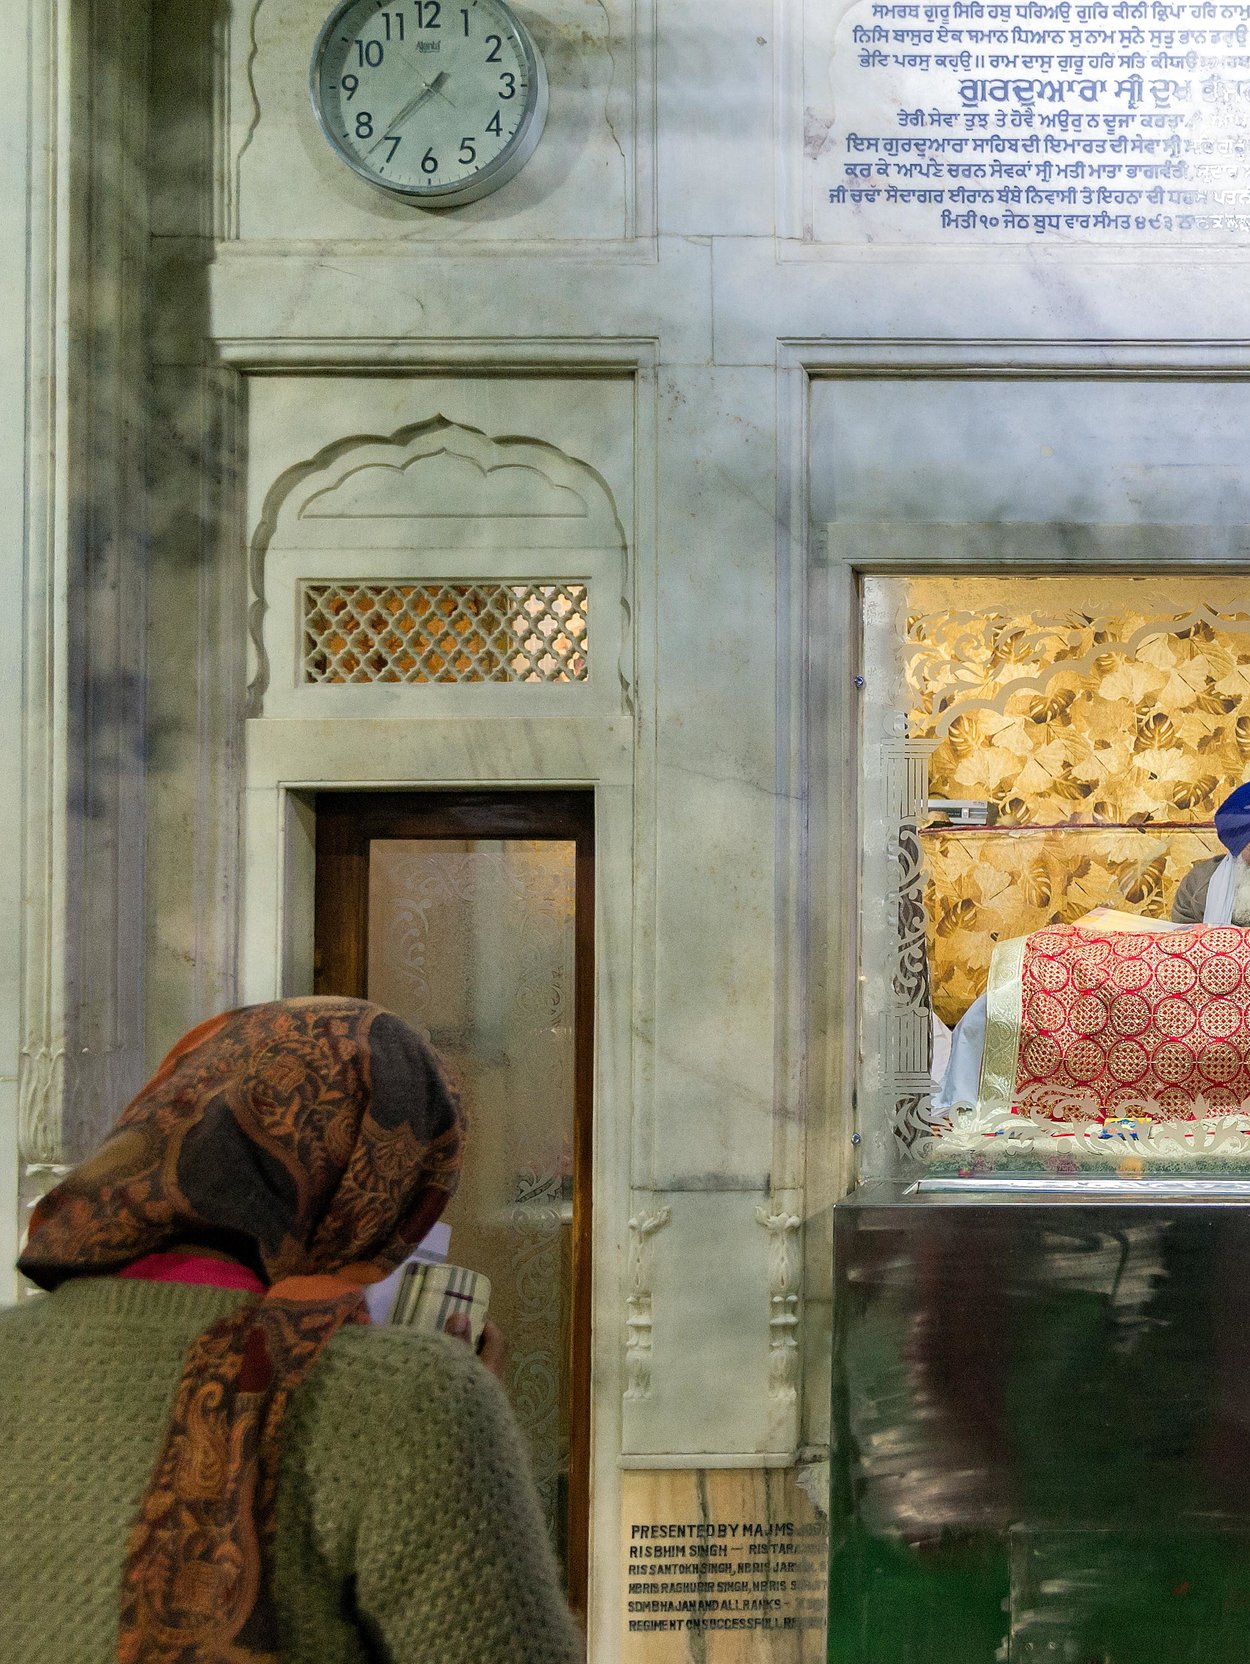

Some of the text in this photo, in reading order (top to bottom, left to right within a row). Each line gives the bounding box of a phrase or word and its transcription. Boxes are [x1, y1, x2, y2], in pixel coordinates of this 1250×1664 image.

[414, 1, 441, 29] 12
[460, 9, 470, 36] 1
[872, 3, 919, 19] ਸਮਰਥ
[924, 5, 950, 24] ਗੁਰੂ
[954, 1, 984, 19] ਸਿਰਿ
[987, 5, 1012, 22] ਹਥੁ
[1076, 1, 1108, 23] ਗੁਰਿ
[1113, 1, 1148, 19] ਕੀਨੀ
[1190, 1, 1217, 18] ਹਰਿ
[1220, 5, 1250, 21] ਨਾਮੁ
[382, 12, 405, 41] 11
[853, 25, 889, 43] ਨਿਸਿ
[938, 26, 963, 43] ਏਕ
[966, 30, 1008, 44] ਸਮਾਨ
[1011, 26, 1065, 44] ਧਿਆਨ
[1085, 30, 1116, 44] ਨਾਮ
[1118, 26, 1145, 48] ਸੁਨੇ
[355, 40, 384, 68] 10
[485, 35, 502, 63] 2
[858, 49, 890, 67] ਭੇਟਿ
[893, 55, 932, 71] ਪਰਸੁ
[989, 55, 1018, 68] ਰਾਮ
[1022, 55, 1054, 73] ਦਾਸੁ
[1057, 55, 1085, 74] ਗੁਰੂ
[1088, 52, 1115, 69] ਹਰਿ
[1118, 52, 1147, 69] ਸਤਿ
[342, 74, 359, 101] 9
[499, 73, 516, 99] 3
[958, 78, 1107, 107] ਗੁਰਦੁਆਰਾ
[1114, 73, 1144, 108] ਸ੍ਰੀ
[355, 112, 374, 139] 8
[485, 110, 503, 137] 4
[897, 109, 926, 127] ਤੇਰੀ
[928, 108, 960, 127] ਸੇਵਾ
[964, 113, 989, 131] ਤੁਝ
[995, 109, 1008, 127] ਤੇ
[1011, 108, 1035, 127] ਹੋਵੈ
[1087, 114, 1100, 128] ਨ
[1103, 113, 1136, 134] ਦੂਜਾ
[384, 136, 402, 164] 7
[458, 138, 476, 165] 5
[846, 134, 879, 153] ਇਸ
[882, 138, 969, 158] ਗੁਰਦੁਆਰਾ
[972, 134, 1020, 153] ਸਾਹਿਬ
[1022, 134, 1040, 153] ਦੀ
[1043, 134, 1107, 154] ਇਮਾਰਤ
[1109, 134, 1129, 153] ਦੀ
[1131, 134, 1161, 154] ਸੇਵਾ
[421, 147, 438, 174] 6
[844, 164, 872, 178] ਕਰ
[876, 159, 891, 177] ਕੇ
[894, 159, 944, 178] ਆਪਣੇ
[947, 164, 986, 178] ਚਰਨ
[989, 159, 1032, 178] ਸੇਵਕਾਂ
[1056, 161, 1086, 179] ਮਤੀ
[1088, 164, 1122, 179] ਮਾਤਾ
[829, 185, 848, 203] ਜੀ
[884, 184, 945, 204] ਸੌਦਾਗਰ
[948, 186, 994, 204] ਈਰਾਨ
[997, 185, 1023, 205] ਬੰਬੇ
[1025, 185, 1077, 204] ਨਿਵਾਸੀ
[1080, 186, 1094, 204] ਤੇ
[1096, 186, 1143, 204] ਇਹਨਾ
[1145, 186, 1165, 204] ਦੀ
[941, 209, 977, 229] ਮਿਤੀ
[979, 215, 1000, 229] ੧੦
[1002, 209, 1029, 229] ਜੇਠ
[1032, 215, 1062, 234] ਬੁਧ
[1063, 215, 1091, 229] ਵਾਰ
[1093, 210, 1131, 229] ਸੰਮਤ
[631, 1524, 739, 1539] PRESENTED BY
[689, 1545, 728, 1556] SINGH
[628, 1620, 684, 1631] REGIMENT
